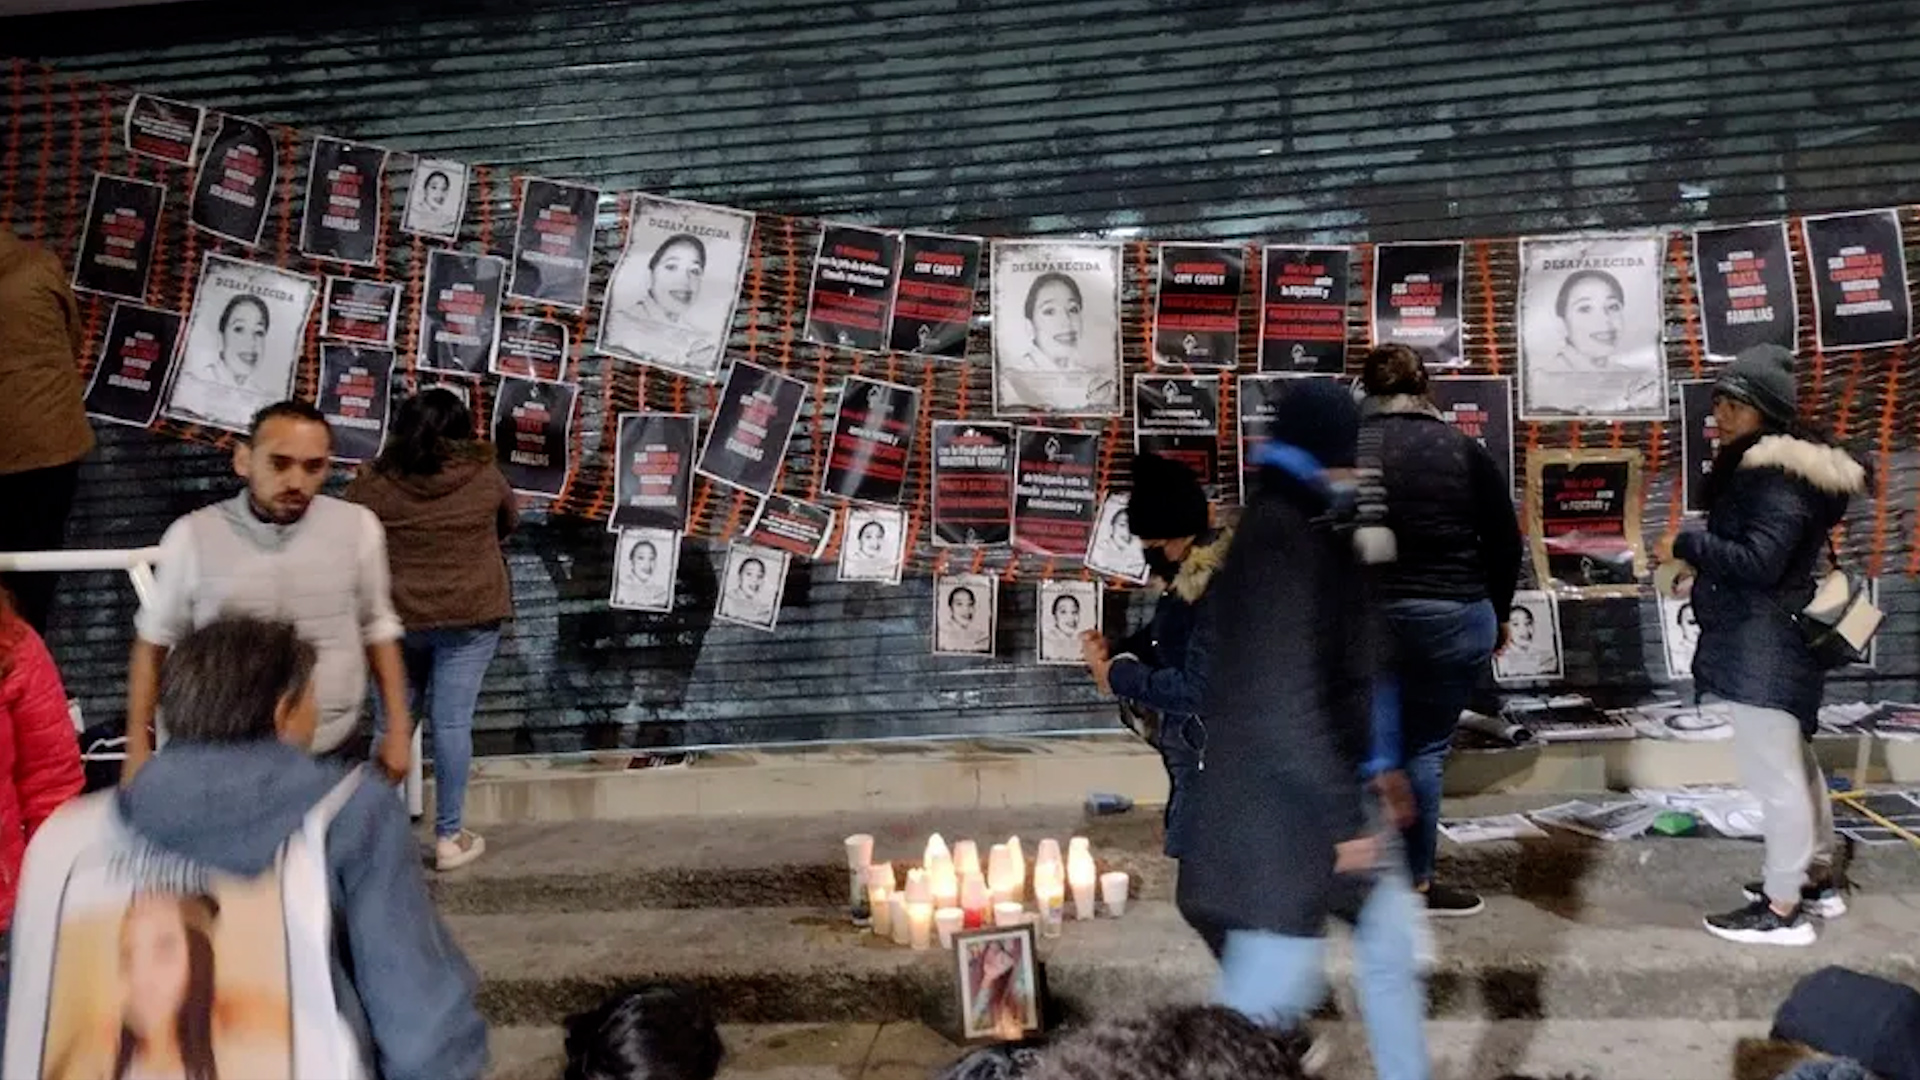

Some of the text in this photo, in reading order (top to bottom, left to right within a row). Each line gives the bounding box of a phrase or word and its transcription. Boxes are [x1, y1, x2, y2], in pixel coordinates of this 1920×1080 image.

[649, 217, 731, 239] DESAPARECIDA
[1012, 261, 1101, 273] DESAPARECIDA
[1542, 257, 1646, 271] DESAPARECIDA
[215, 277, 294, 302] DESAPARECIDA
[1726, 306, 1774, 325] FAMILIAS
